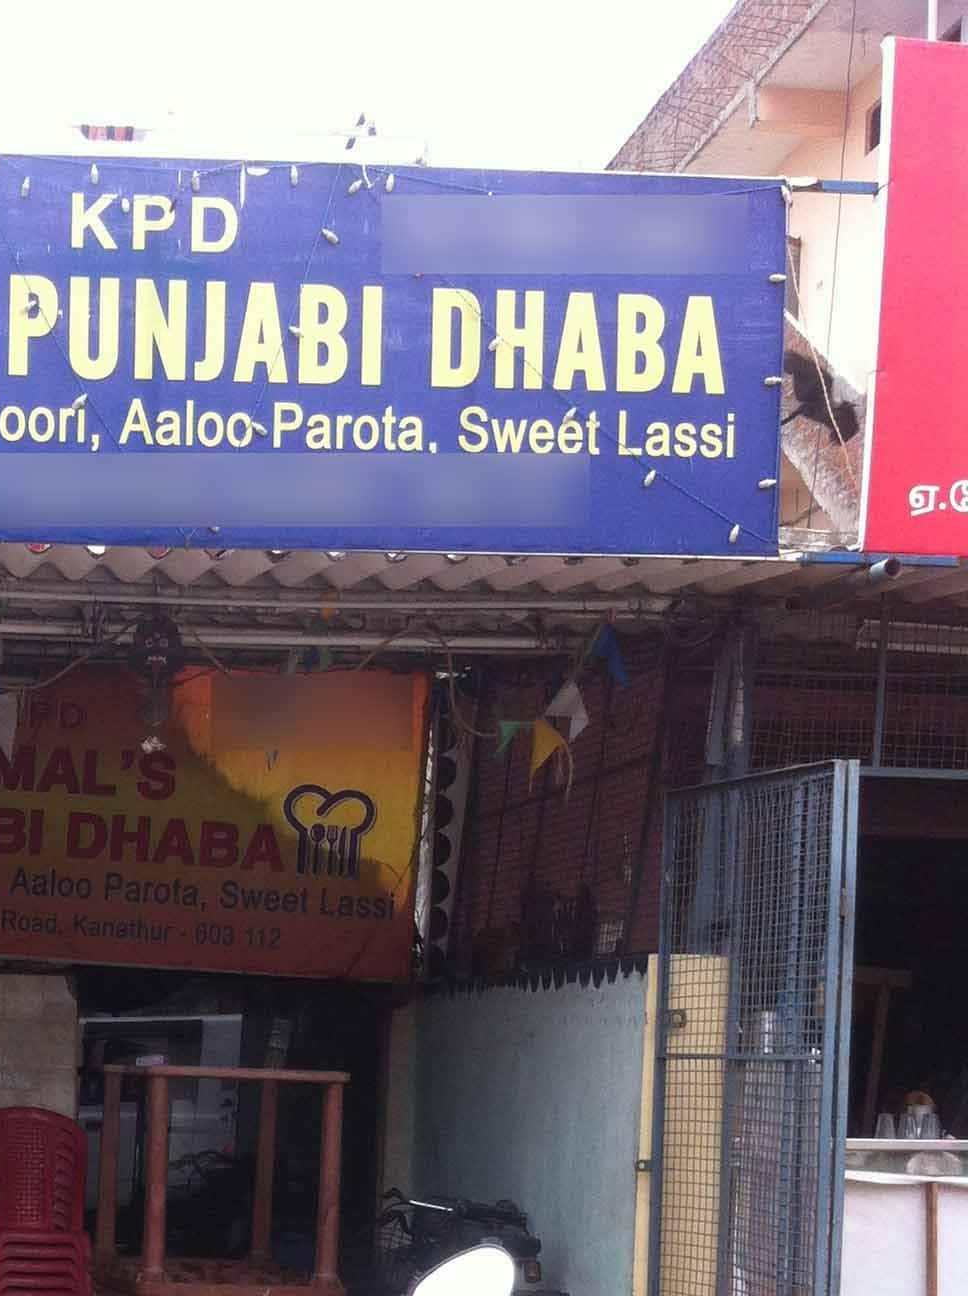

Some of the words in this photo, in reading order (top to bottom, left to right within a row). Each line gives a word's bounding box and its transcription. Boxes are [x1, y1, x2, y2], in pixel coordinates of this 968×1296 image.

[69, 191, 239, 253] KPD
[7, 273, 384, 387] PUNJABI
[430, 288, 726, 396] DHABA
[117, 398, 254, 449] Aaloo
[617, 410, 736, 459] Lassi
[64, 813, 286, 872] DHABA
[9, 867, 92, 899] Aaloo
[220, 882, 308, 915] Sweet
[319, 886, 395, 920] Lassi
[245, 925, 281, 950] 112
